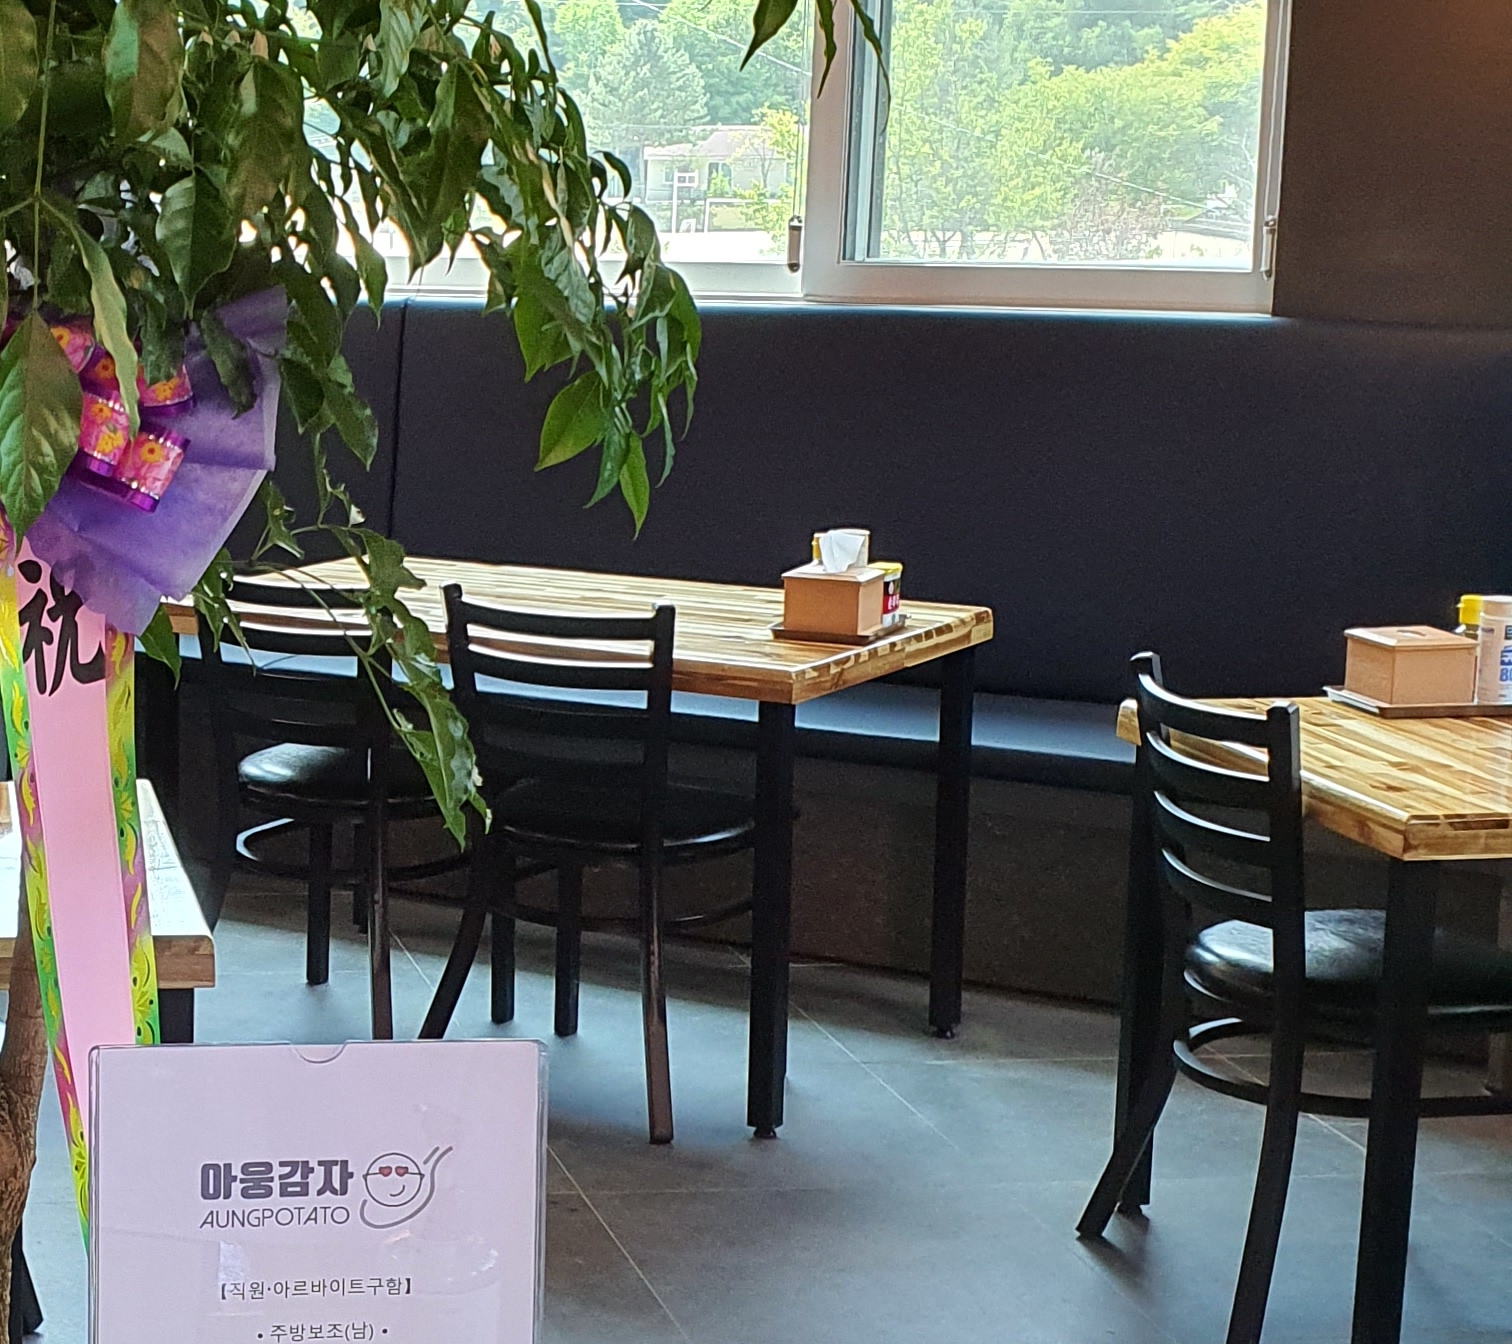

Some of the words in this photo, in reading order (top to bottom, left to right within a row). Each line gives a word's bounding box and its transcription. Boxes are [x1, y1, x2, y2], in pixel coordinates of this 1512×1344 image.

[18, 560, 106, 697] 祝
[200, 1159, 354, 1200] 아웅감자
[199, 1206, 350, 1229] AUNGPOTATO
[270, 1321, 374, 1343] 주방보조(남)
